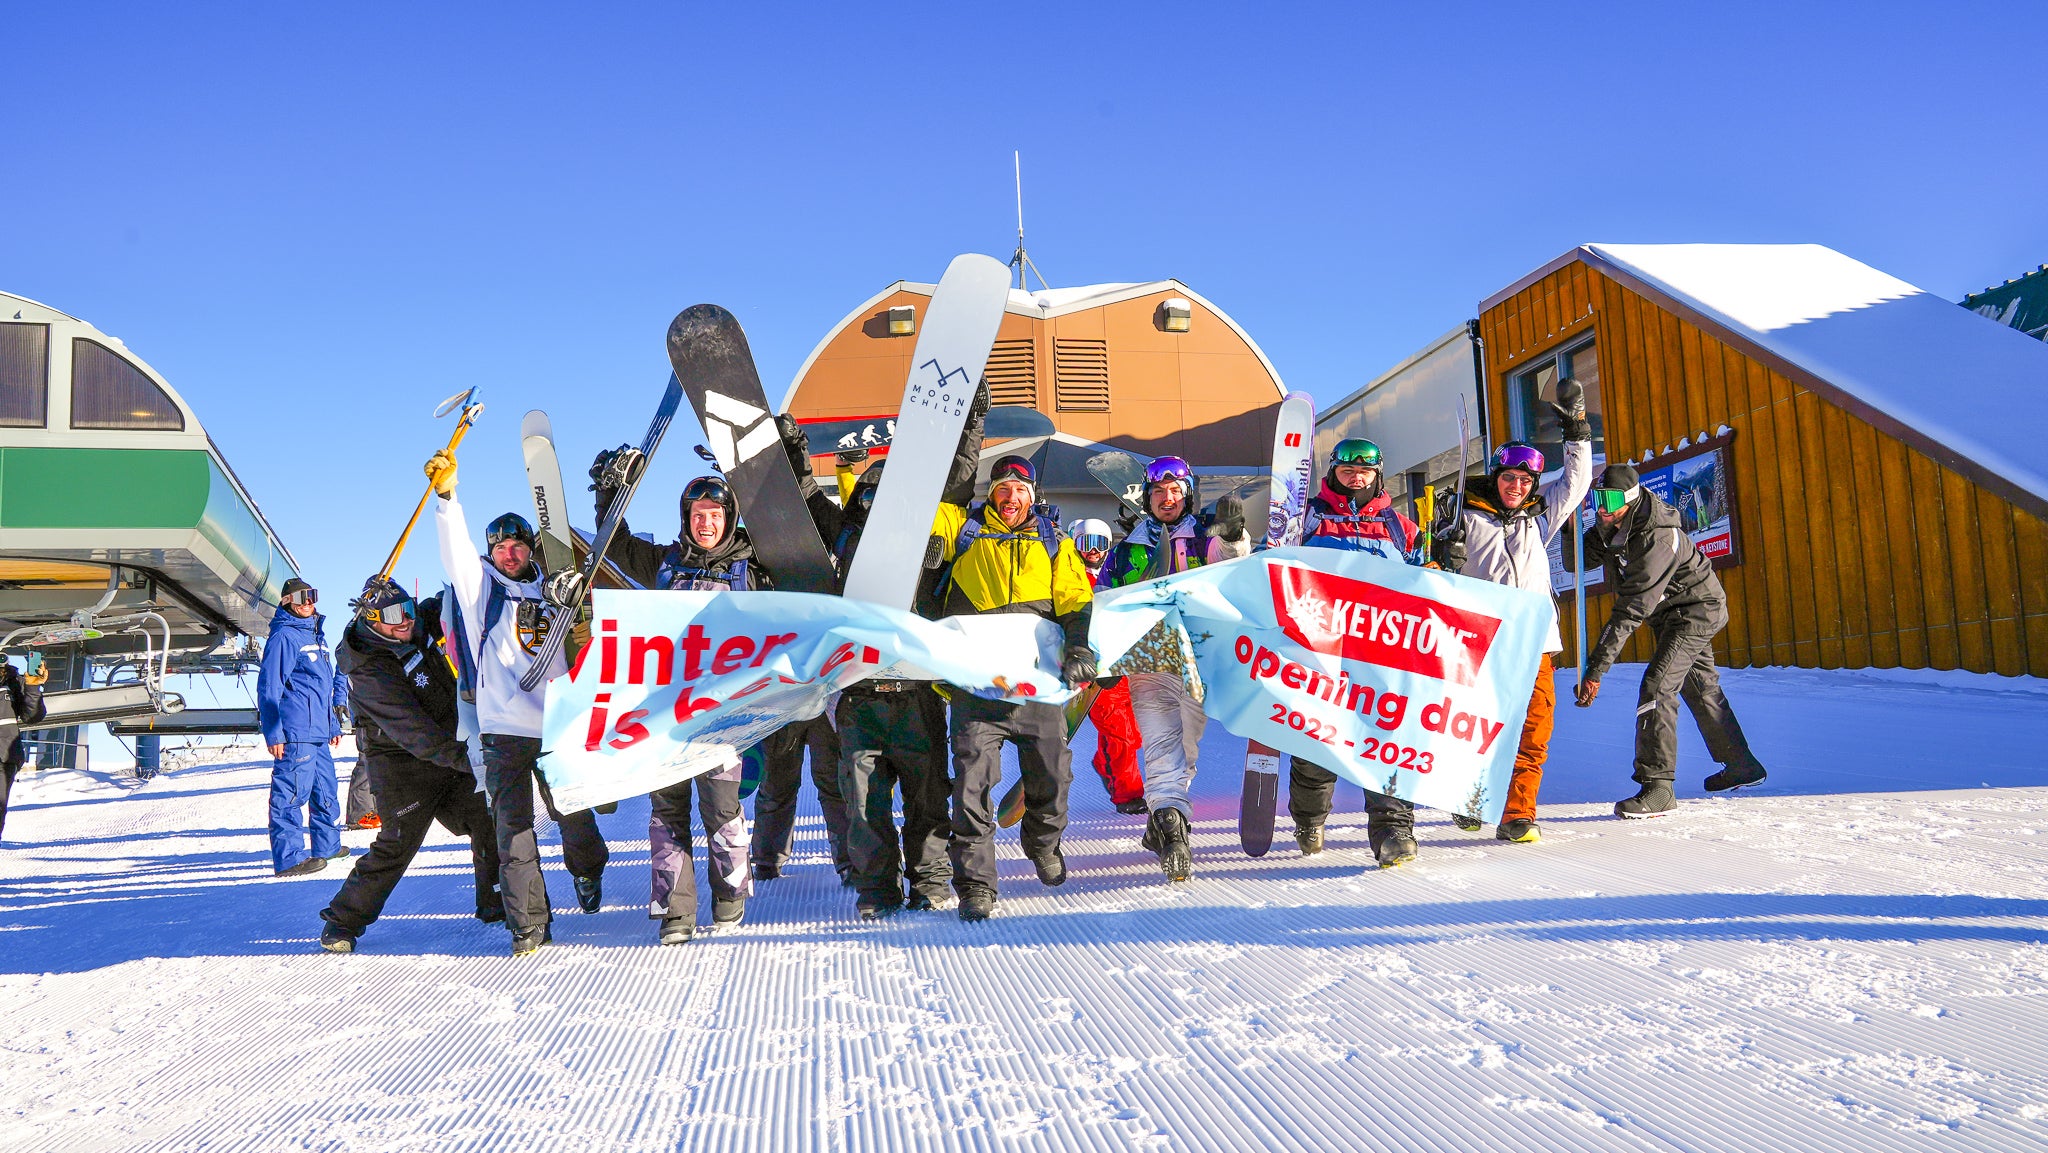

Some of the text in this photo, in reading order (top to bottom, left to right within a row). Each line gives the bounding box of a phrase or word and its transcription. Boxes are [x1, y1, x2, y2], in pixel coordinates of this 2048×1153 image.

[910, 395, 961, 417] CHILD
[912, 384, 965, 407] MOON
[534, 485, 552, 531] FACTION
[1235, 634, 1505, 755] opening day
[585, 693, 650, 752] is
[1268, 703, 1338, 746] 2022
[1359, 737, 1435, 774] 2023
